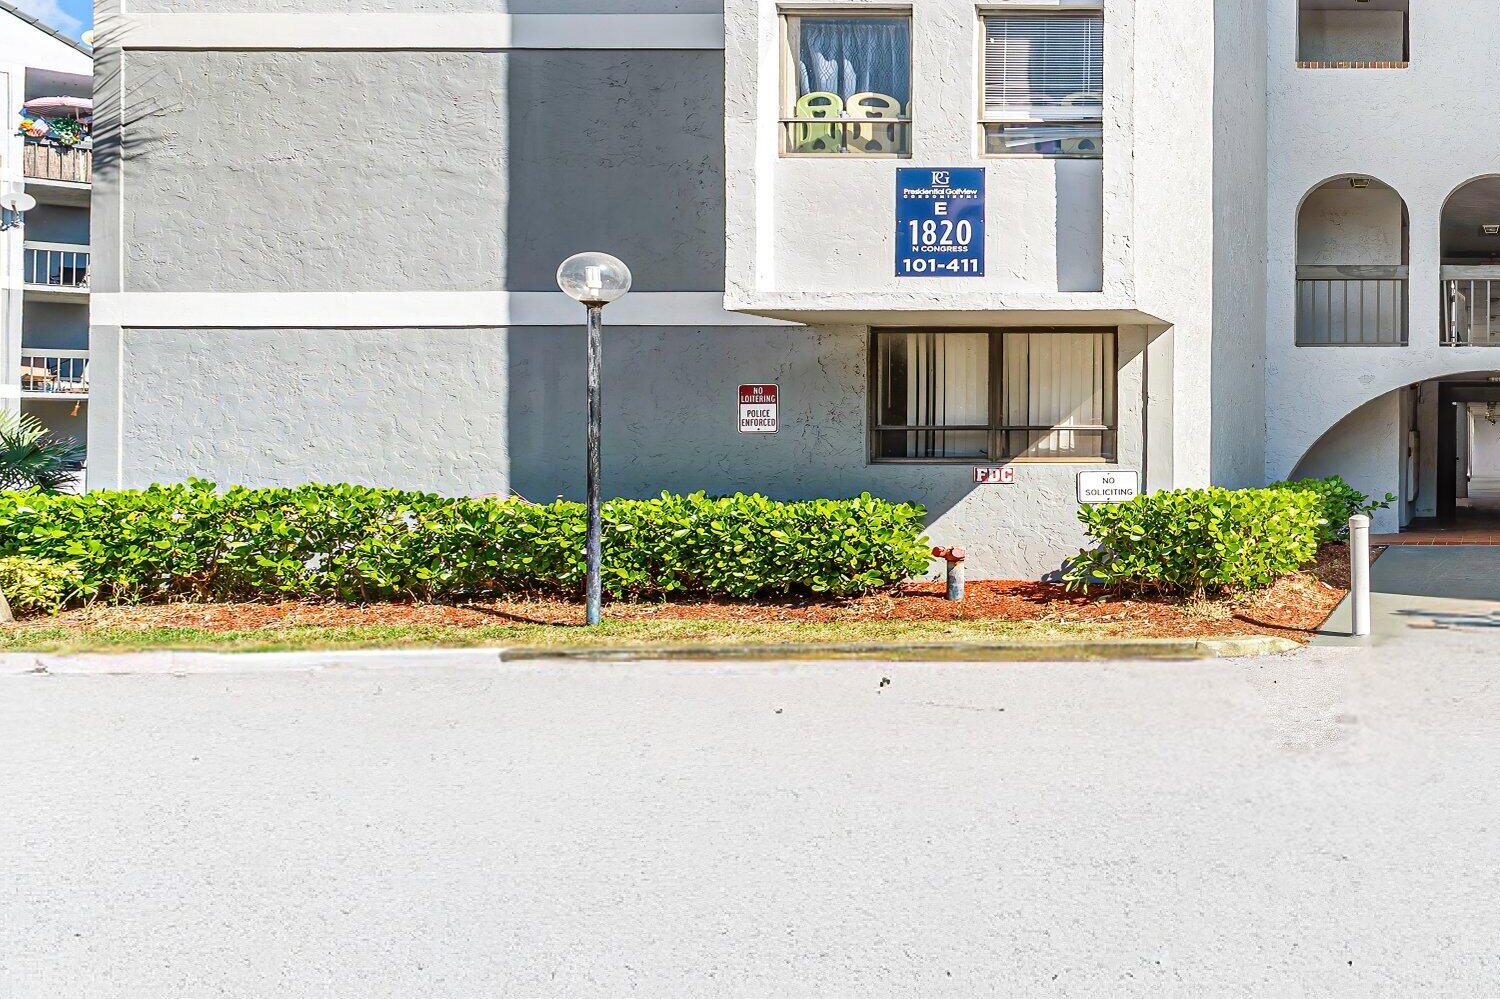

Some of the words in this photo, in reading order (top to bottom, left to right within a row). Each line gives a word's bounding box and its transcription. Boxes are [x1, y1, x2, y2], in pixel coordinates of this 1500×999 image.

[934, 202, 947, 215] E
[909, 220, 971, 245] 1820
[903, 259, 977, 272] 101-411
[977, 468, 1013, 481] FDC
[1085, 488, 1133, 496] SOLICITING
